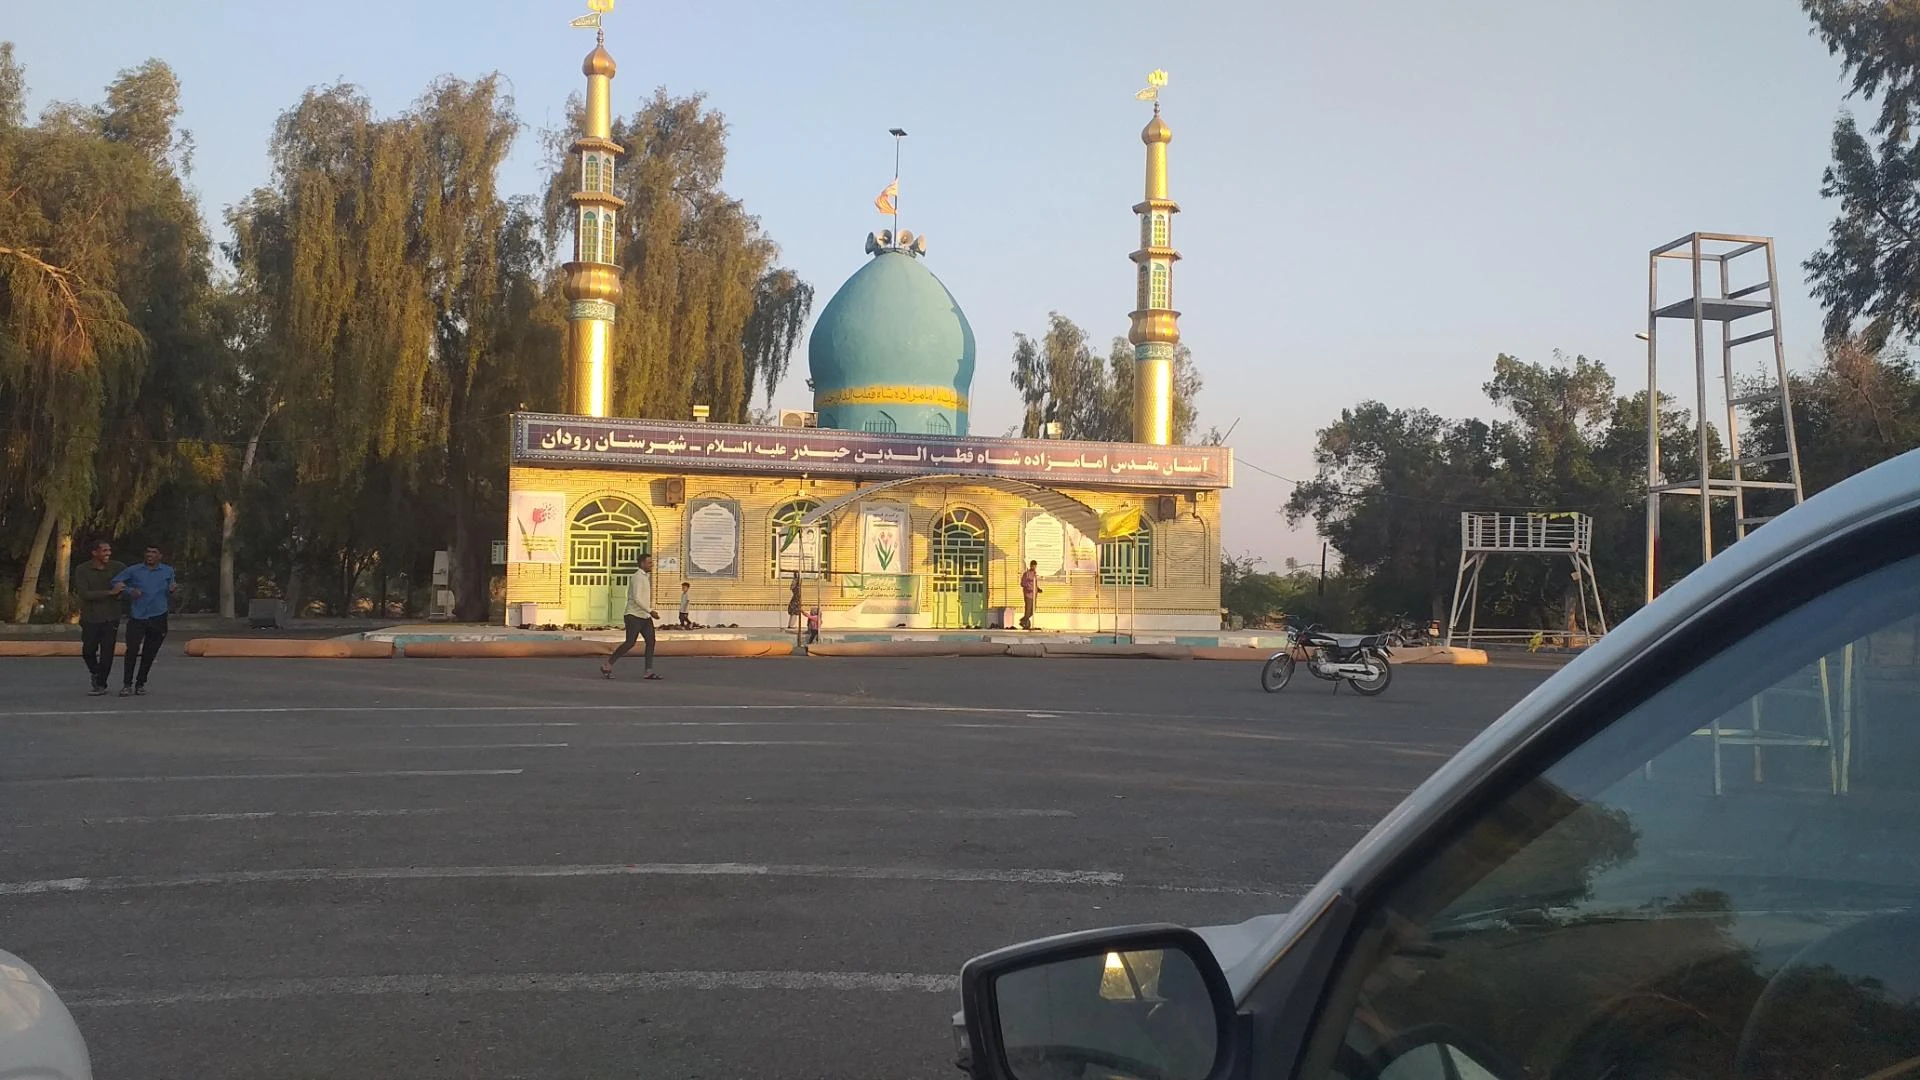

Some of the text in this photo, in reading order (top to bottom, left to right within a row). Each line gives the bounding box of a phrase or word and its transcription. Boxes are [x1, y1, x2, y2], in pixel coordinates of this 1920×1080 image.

[541, 427, 591, 451] رودان
[594, 430, 687, 454] شهرستان
[706, 439, 752, 456] السلام
[754, 442, 787, 458] علیه
[790, 443, 851, 461] حیدر
[854, 445, 927, 464] الدین
[930, 447, 974, 466] قطب
[977, 448, 1021, 465] شاه
[1024, 451, 1108, 472] امامزاده
[1110, 456, 1159, 474] مقدس
[1162, 455, 1210, 476] آستان
